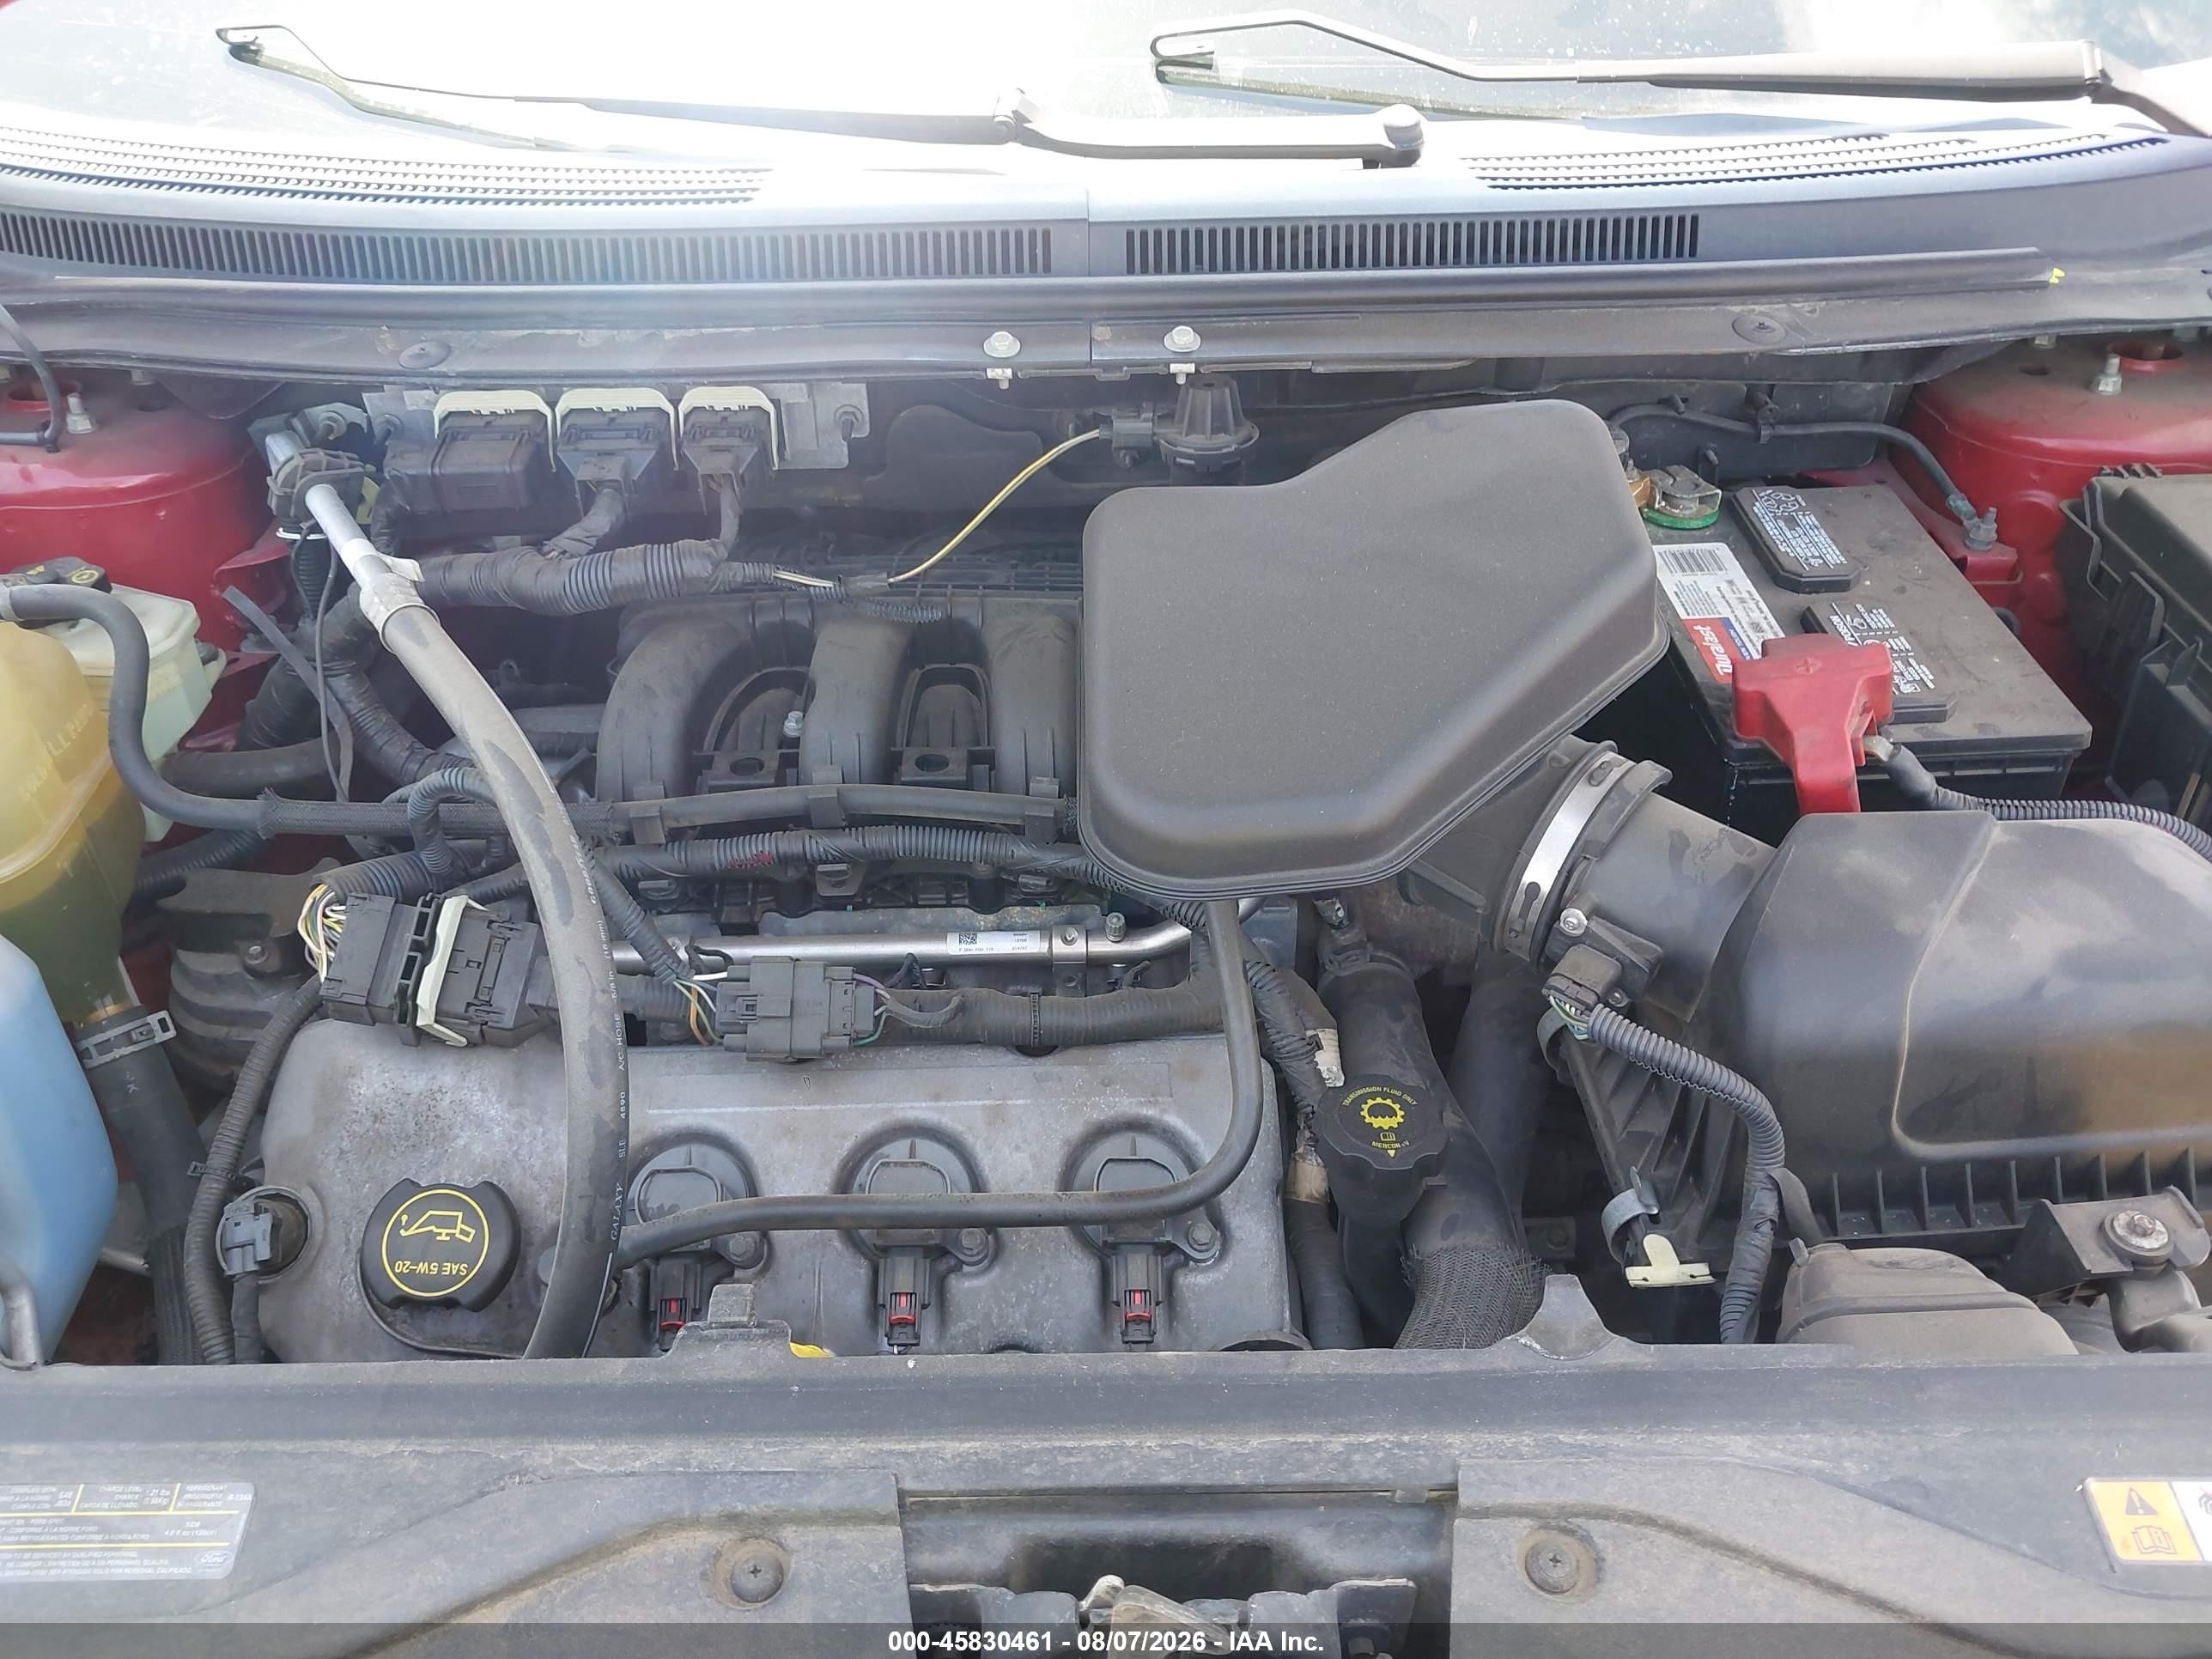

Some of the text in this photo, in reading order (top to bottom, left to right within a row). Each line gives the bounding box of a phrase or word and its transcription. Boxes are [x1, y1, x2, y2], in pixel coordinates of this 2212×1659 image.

[1692, 624, 1734, 676] Duralast
[613, 1013, 624, 1046] HOSE
[1341, 1085, 1419, 1107] TRANSMISSION FLUID ONLY
[1371, 1140, 1401, 1149] MERCON
[611, 1181, 624, 1241] GALAXY
[394, 1260, 469, 1277] SAE 5W-20
